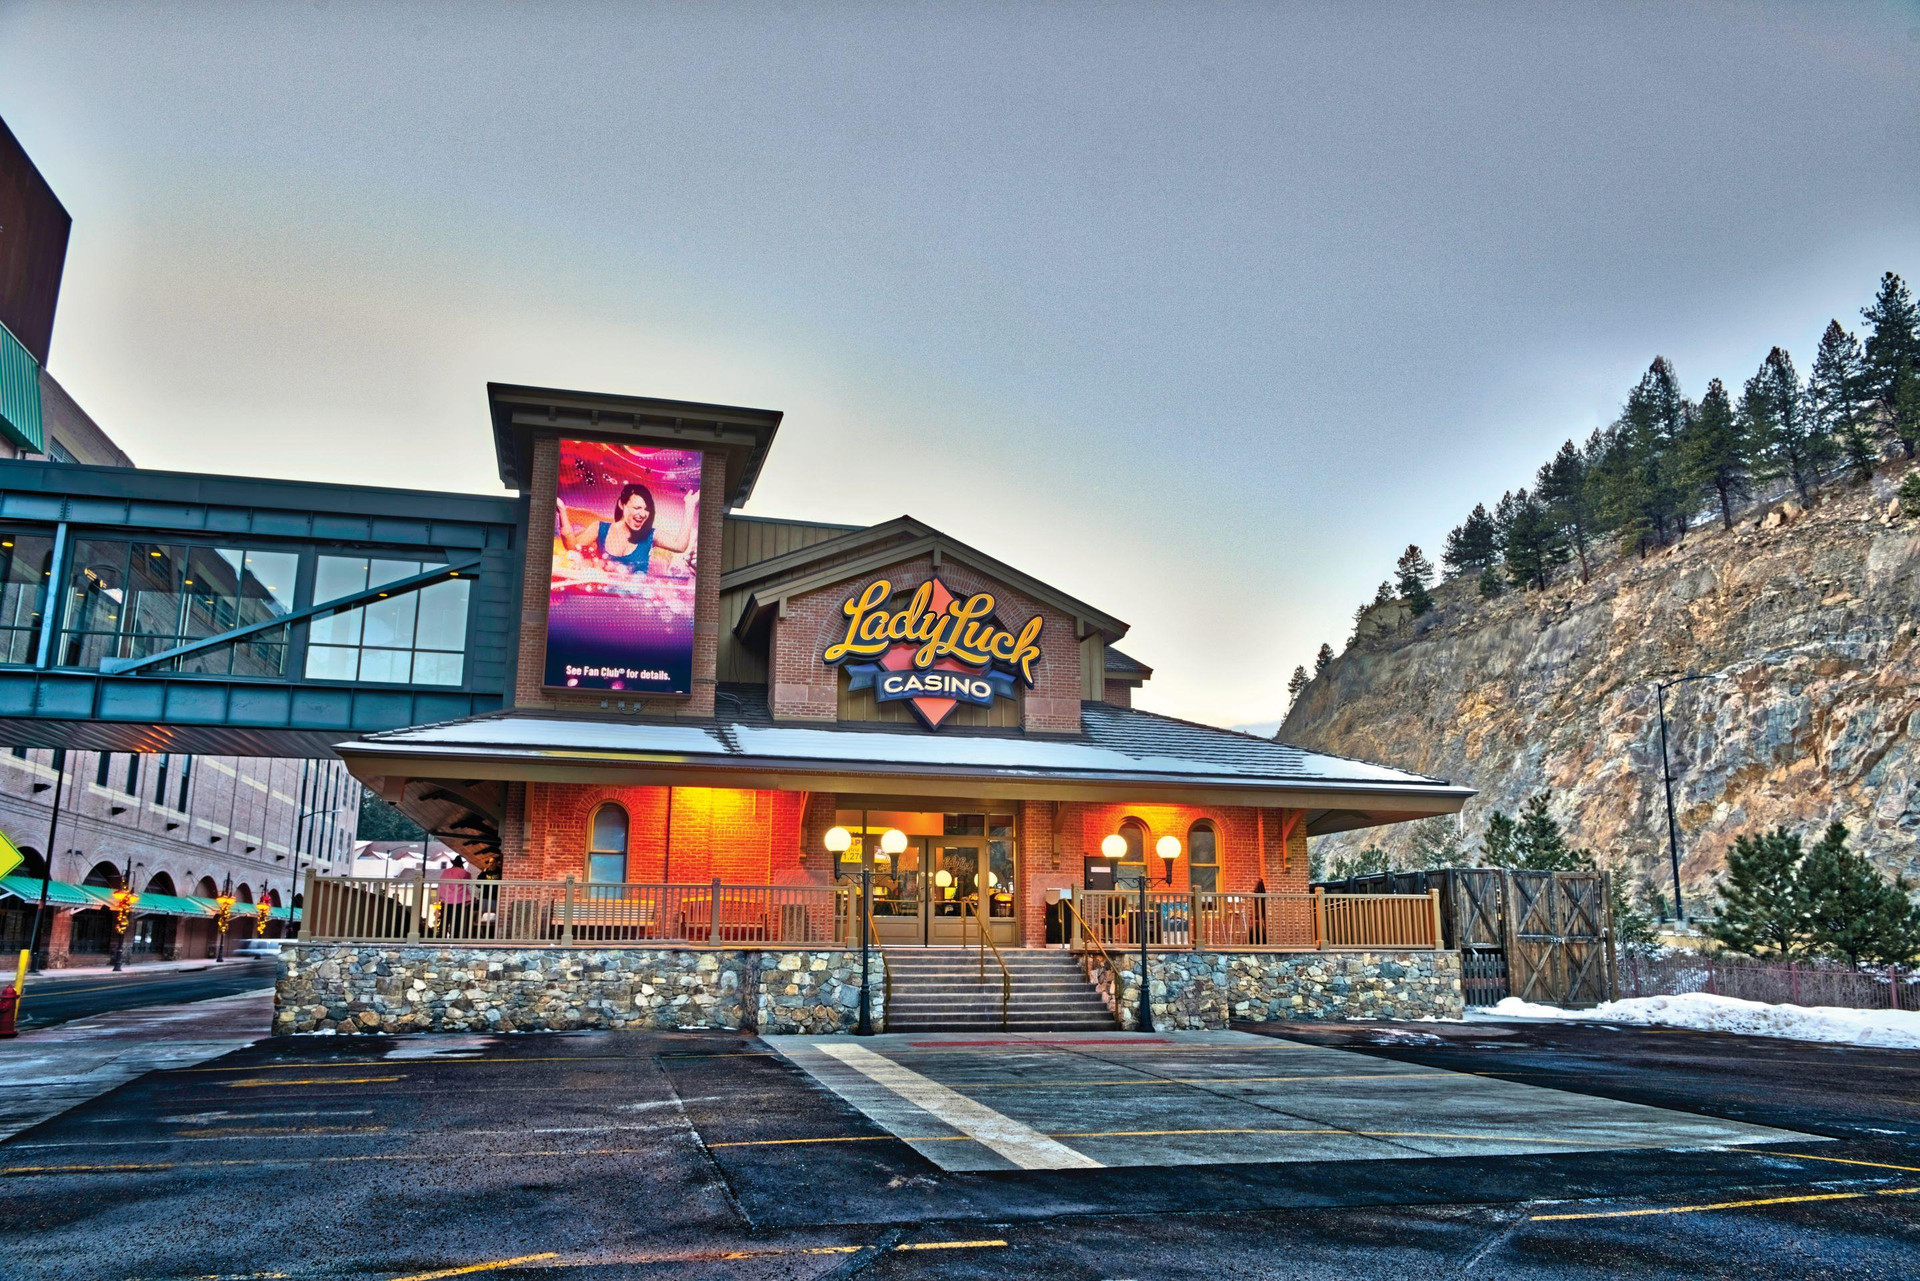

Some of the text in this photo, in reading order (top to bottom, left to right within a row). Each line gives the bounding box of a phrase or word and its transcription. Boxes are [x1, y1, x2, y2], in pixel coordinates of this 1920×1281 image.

[824, 579, 1044, 684] Lady Luck
[565, 664, 582, 676] See
[583, 665, 599, 677] Fan
[626, 668, 639, 679] for
[640, 669, 671, 681] details.
[883, 674, 992, 699] CASINO
